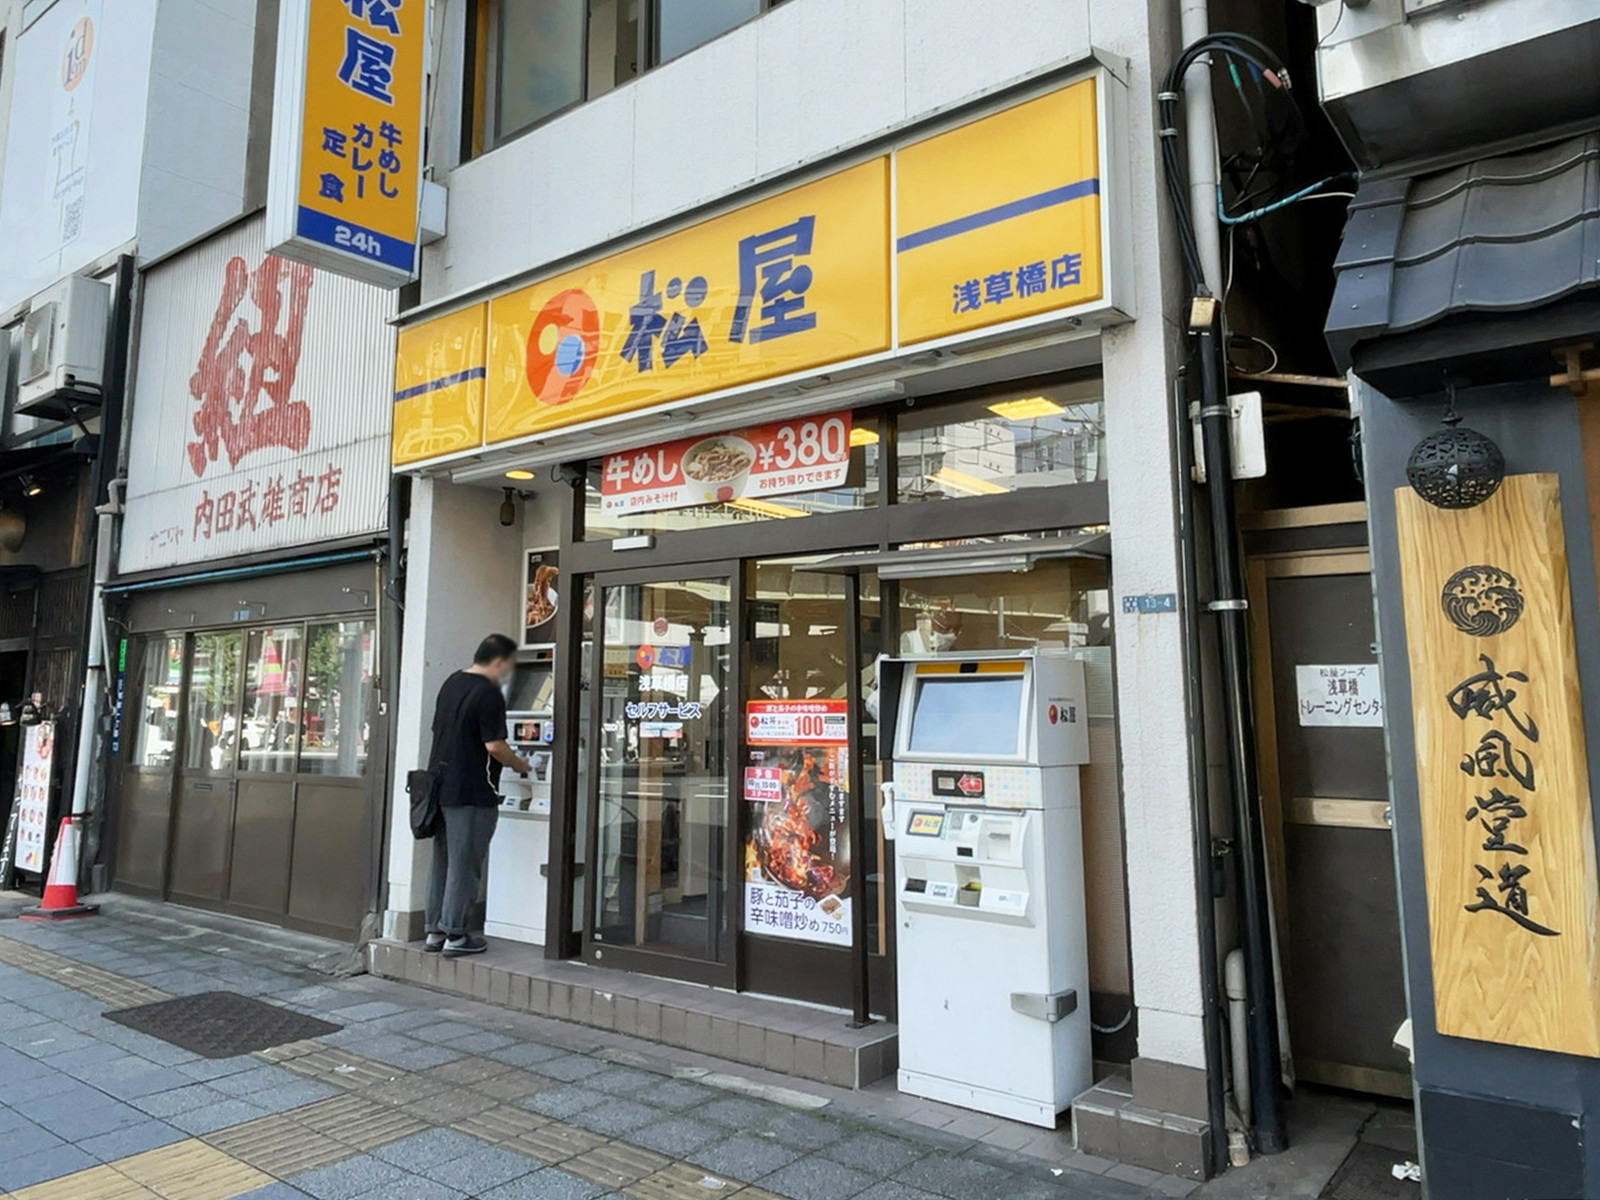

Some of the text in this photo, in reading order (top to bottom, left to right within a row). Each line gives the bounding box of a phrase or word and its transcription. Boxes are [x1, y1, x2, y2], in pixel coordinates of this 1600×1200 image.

[318, 126, 347, 204] 定食
[351, 122, 374, 200] カレー
[378, 120, 403, 199] 牛めし
[334, 225, 382, 257] 24h
[620, 214, 817, 374] 松屋
[952, 252, 1083, 315] 浅草橋店
[606, 417, 846, 491] 牛めし ¥380
[759, 467, 842, 490] お持ち帰りできます
[193, 462, 343, 543] 内田武雄商店
[1319, 667, 1366, 678] 松屋フーズ
[1327, 678, 1359, 697] 浅草橋
[625, 701, 702, 720] セルフサービス
[1300, 698, 1382, 716] トレーニングセンタ
[794, 715, 824, 737] 100
[1445, 653, 1562, 937] 威風堂道
[750, 886, 817, 911] 豚と茄子の
[750, 907, 820, 933] 辛味噌炒め
